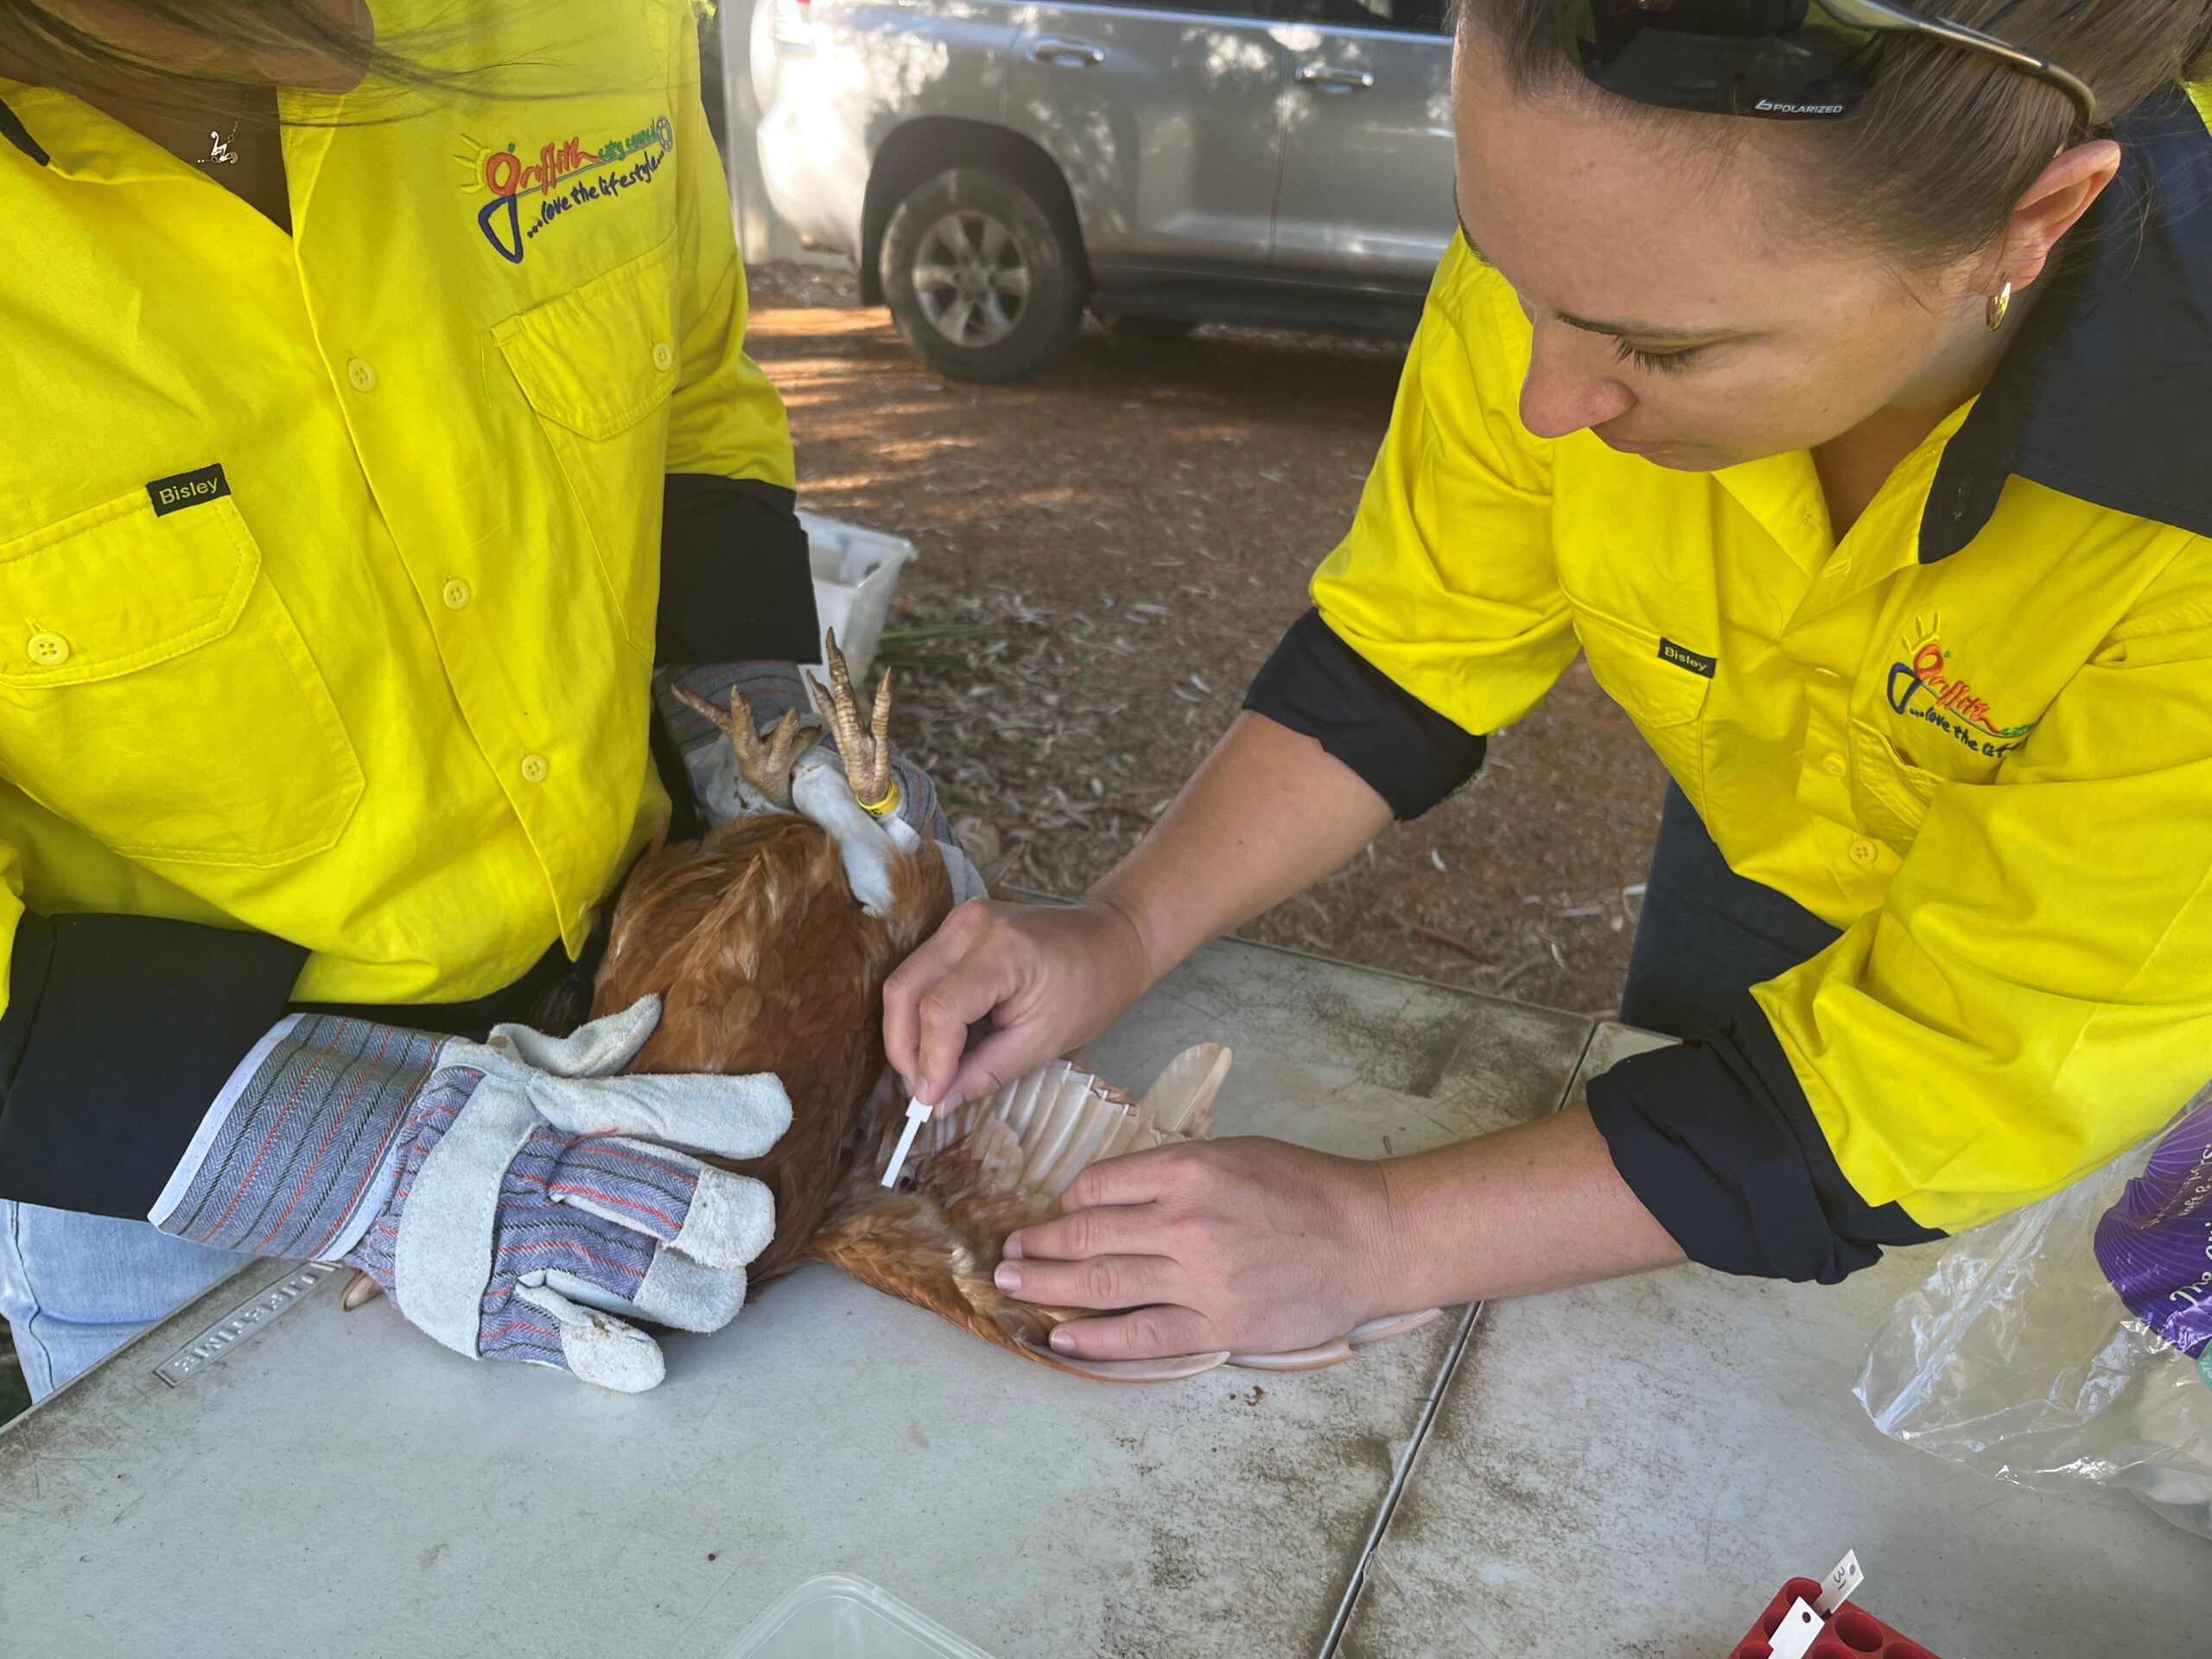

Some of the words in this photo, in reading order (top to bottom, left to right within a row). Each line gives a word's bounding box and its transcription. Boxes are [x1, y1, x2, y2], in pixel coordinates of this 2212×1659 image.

[1773, 104, 1843, 113] POLARIZED
[570, 181, 600, 205] the
[159, 477, 218, 505] Bisley
[1664, 646, 1707, 671] Bisley
[1953, 726, 1979, 751] the
[175, 1274, 315, 1371] LIFETIME
